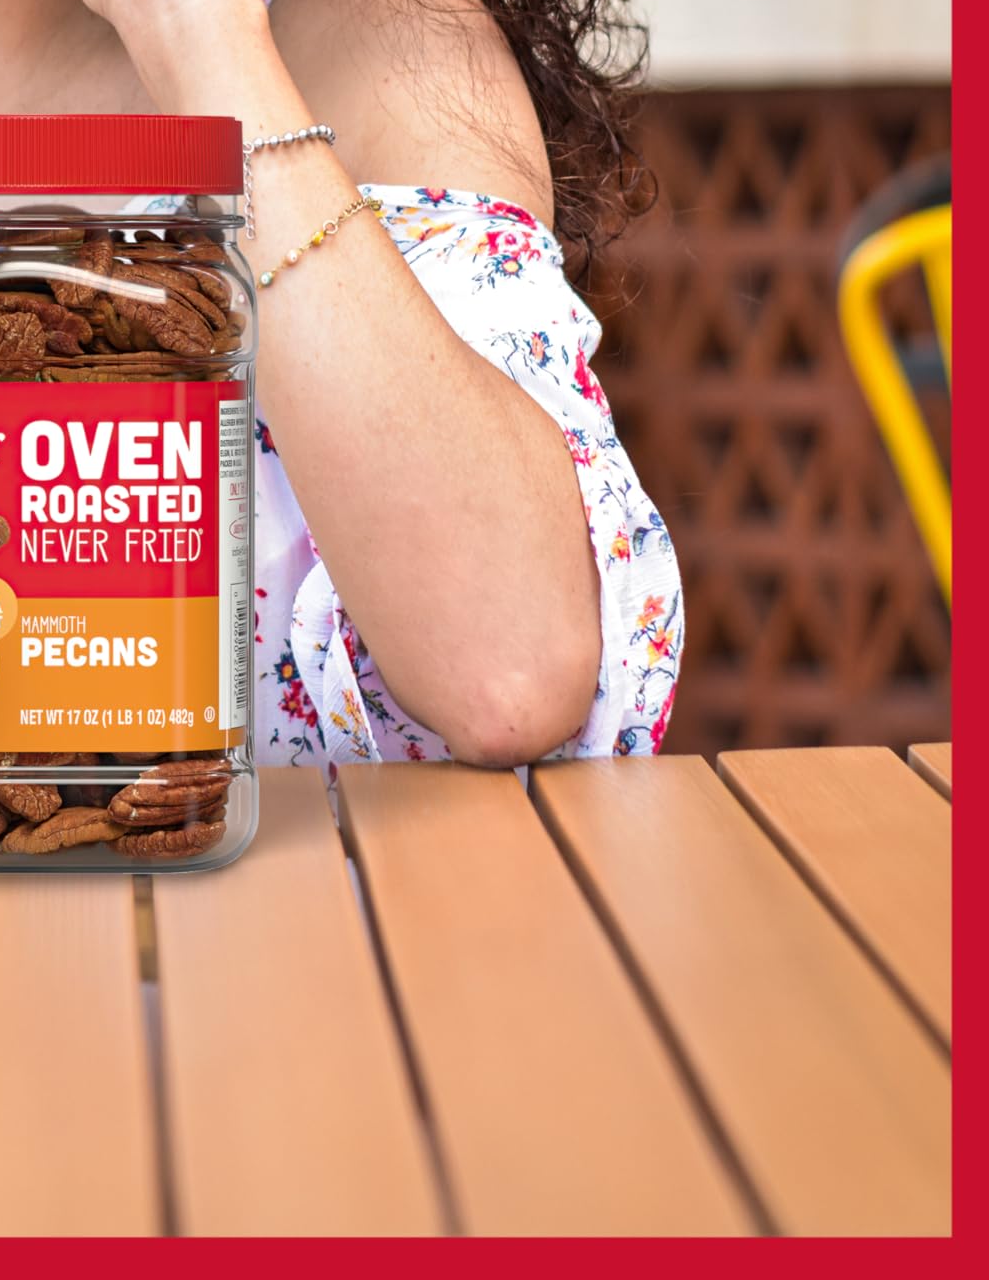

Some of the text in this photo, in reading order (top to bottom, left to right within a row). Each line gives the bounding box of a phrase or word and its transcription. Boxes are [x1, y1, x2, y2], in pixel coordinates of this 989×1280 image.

[21, 420, 202, 481] OVEN
[21, 484, 202, 523] ROASTED
[21, 528, 203, 563] NEVER FRIED
[21, 616, 87, 634] MAMMOTH
[21, 636, 158, 667] PECANS
[20, 708, 194, 728] NET WT 17 OZ (1 LB 1 OZ) 482g
